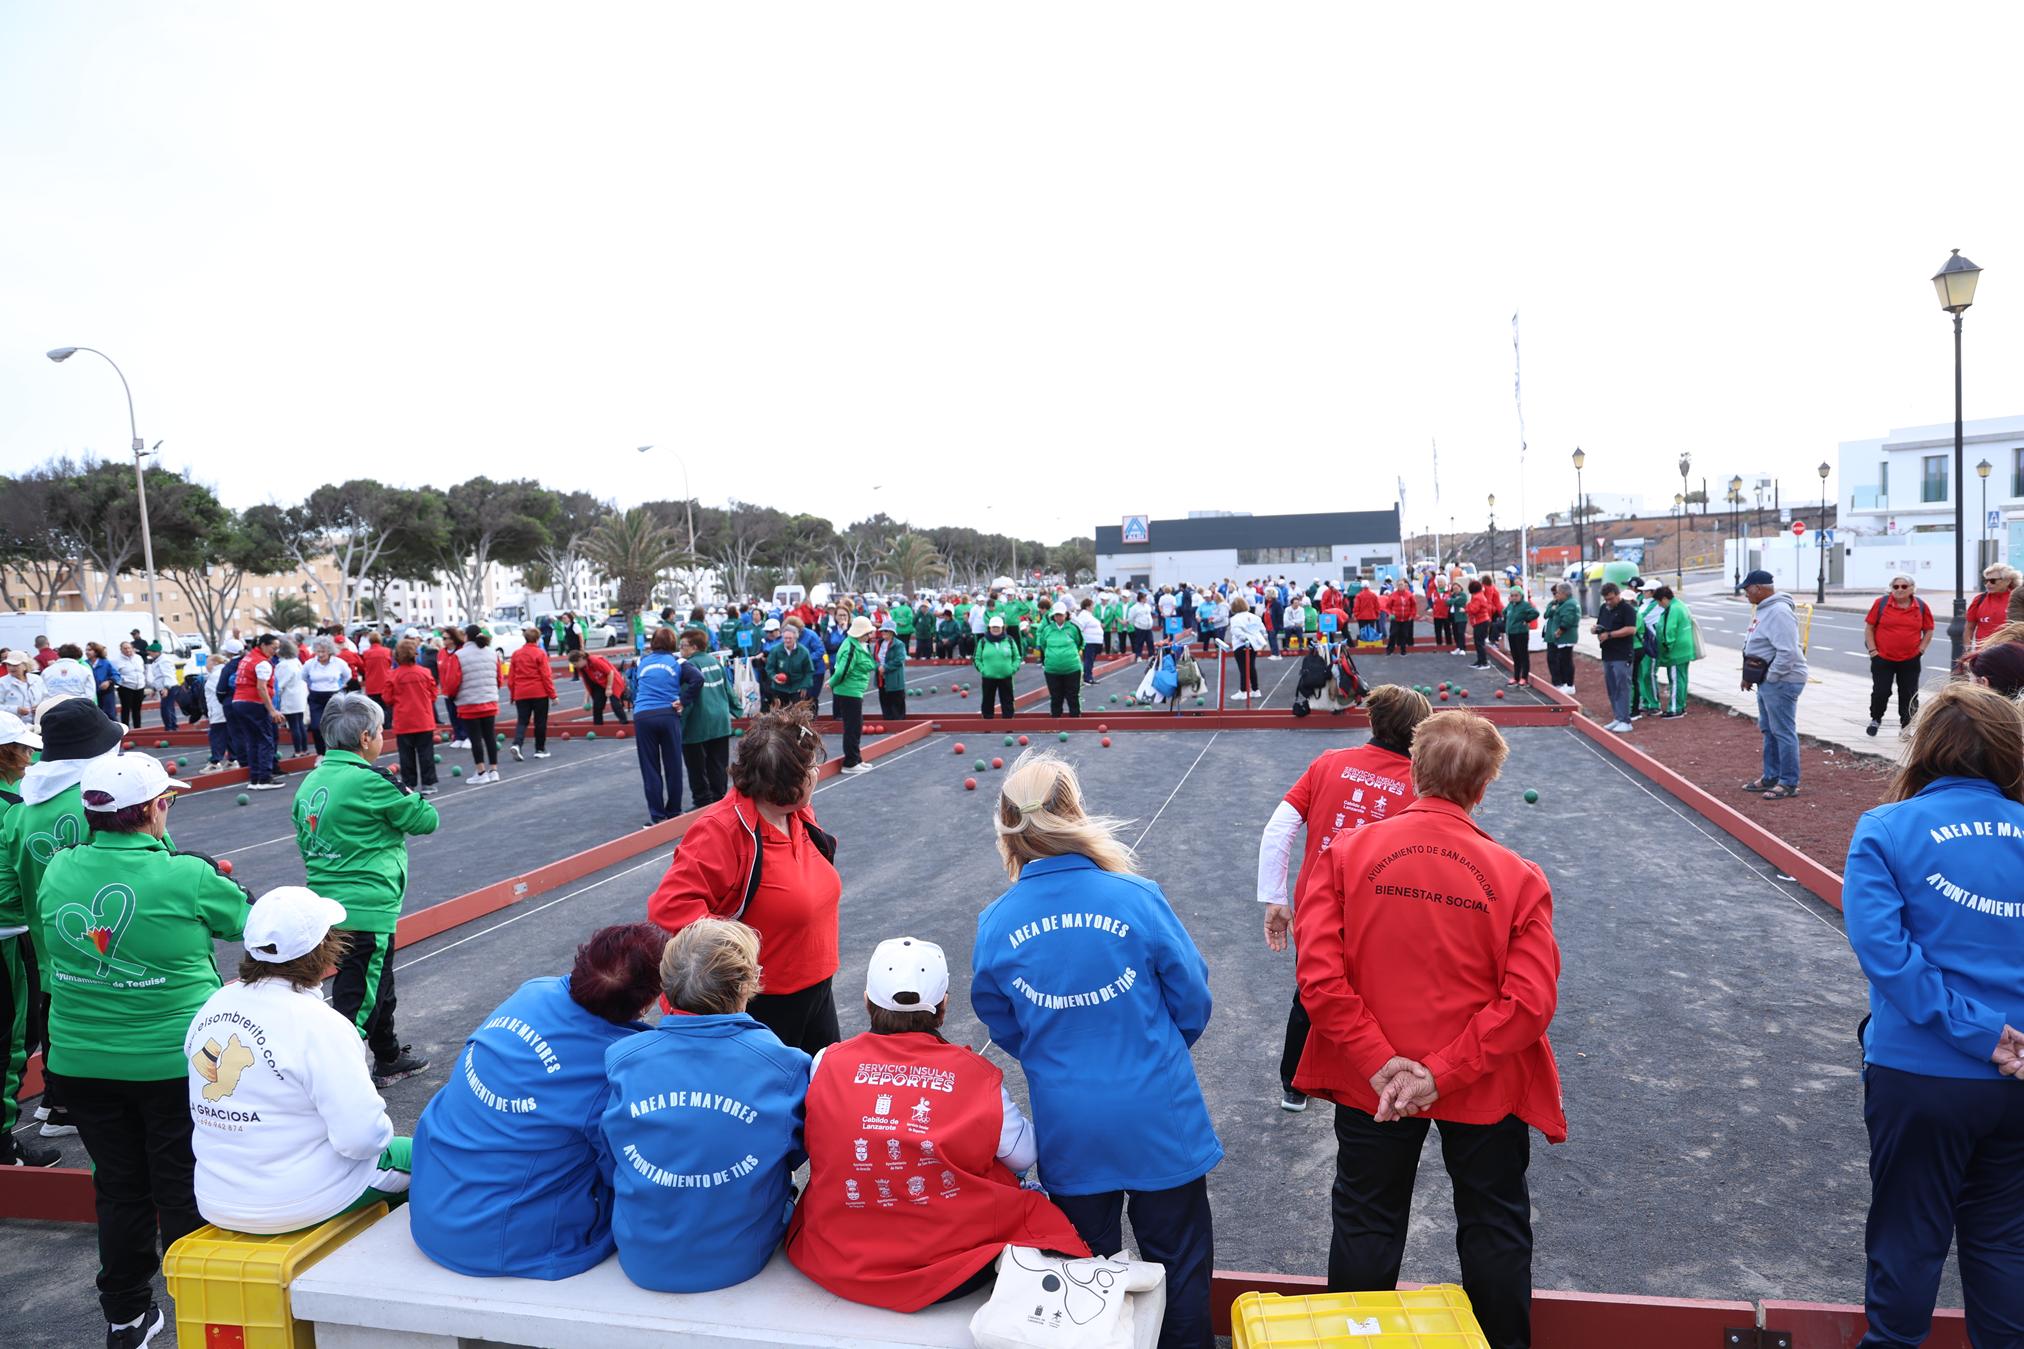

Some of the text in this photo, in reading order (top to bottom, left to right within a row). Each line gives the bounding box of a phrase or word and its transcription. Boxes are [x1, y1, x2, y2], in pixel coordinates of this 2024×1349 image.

[1341, 771, 1405, 796] DEPORTES
[1973, 821, 1993, 836] DE
[1997, 822, 2024, 839] MA
[1367, 845, 1425, 882] AYUNTAMIENTO
[1426, 845, 1439, 855] DE
[1440, 848, 1460, 860] SAN
[1375, 885, 1490, 914] BIENESTAR SOCIAL
[1041, 914, 1059, 932] DE
[1061, 913, 1130, 938] MAYORES
[126, 976, 166, 988] Teguise
[1012, 976, 1100, 1010] AYUNTAMIENTO
[1099, 984, 1118, 1003] DE
[506, 1017, 524, 1033] DE
[517, 1023, 561, 1074] MAYORES
[853, 1071, 956, 1093] DEPORTES
[858, 1063, 956, 1081] SERVICIO INSULAR
[197, 1104, 262, 1123] GRACIOSA
[495, 1096, 509, 1113] DE
[669, 1091, 687, 1107] DE
[689, 1091, 758, 1125] MAYORES
[862, 1115, 889, 1124] Cabildo
[862, 1123, 897, 1131] Lanzarote
[623, 1144, 711, 1188] AYUNTAMIENTO
[712, 1169, 731, 1186] DE
